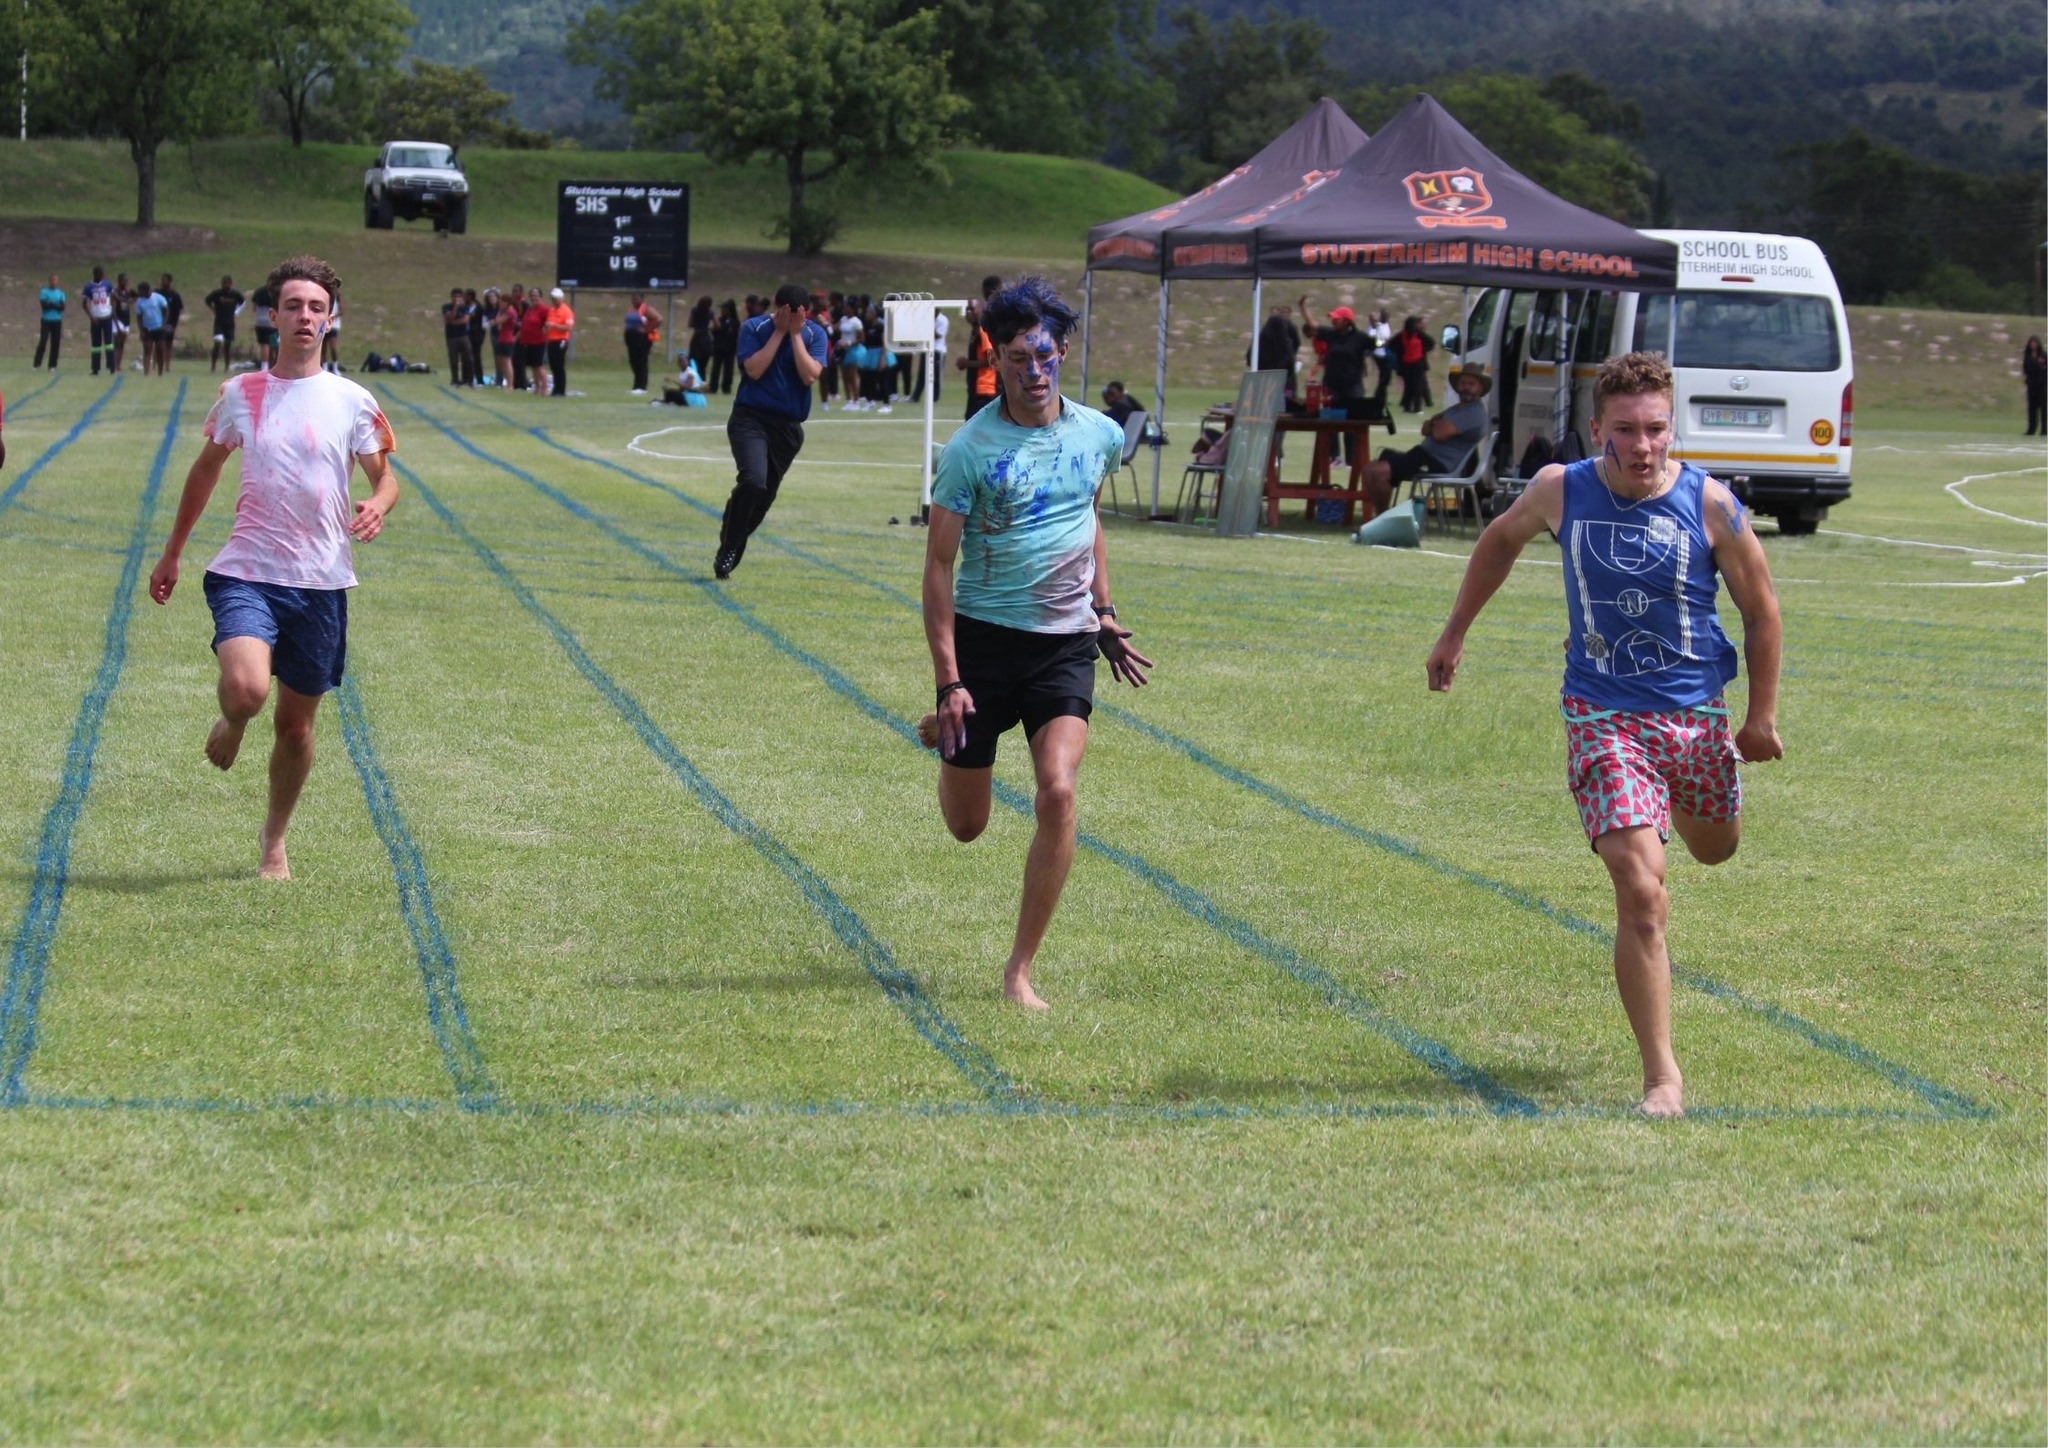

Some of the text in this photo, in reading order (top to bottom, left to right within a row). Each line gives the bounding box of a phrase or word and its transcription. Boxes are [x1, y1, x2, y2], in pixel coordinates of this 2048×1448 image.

[623, 187, 646, 199] High
[648, 187, 683, 198] School
[575, 196, 662, 215] SHS V
[1683, 240, 1789, 261] SCHOOL BUS
[609, 255, 638, 270] U 15
[1300, 242, 1640, 278] STUTTERHEIM HIGH SCHOOL
[1740, 263, 1768, 275] HIGH
[1771, 264, 1815, 279] SCHOOL
[1814, 427, 1831, 439] 100
